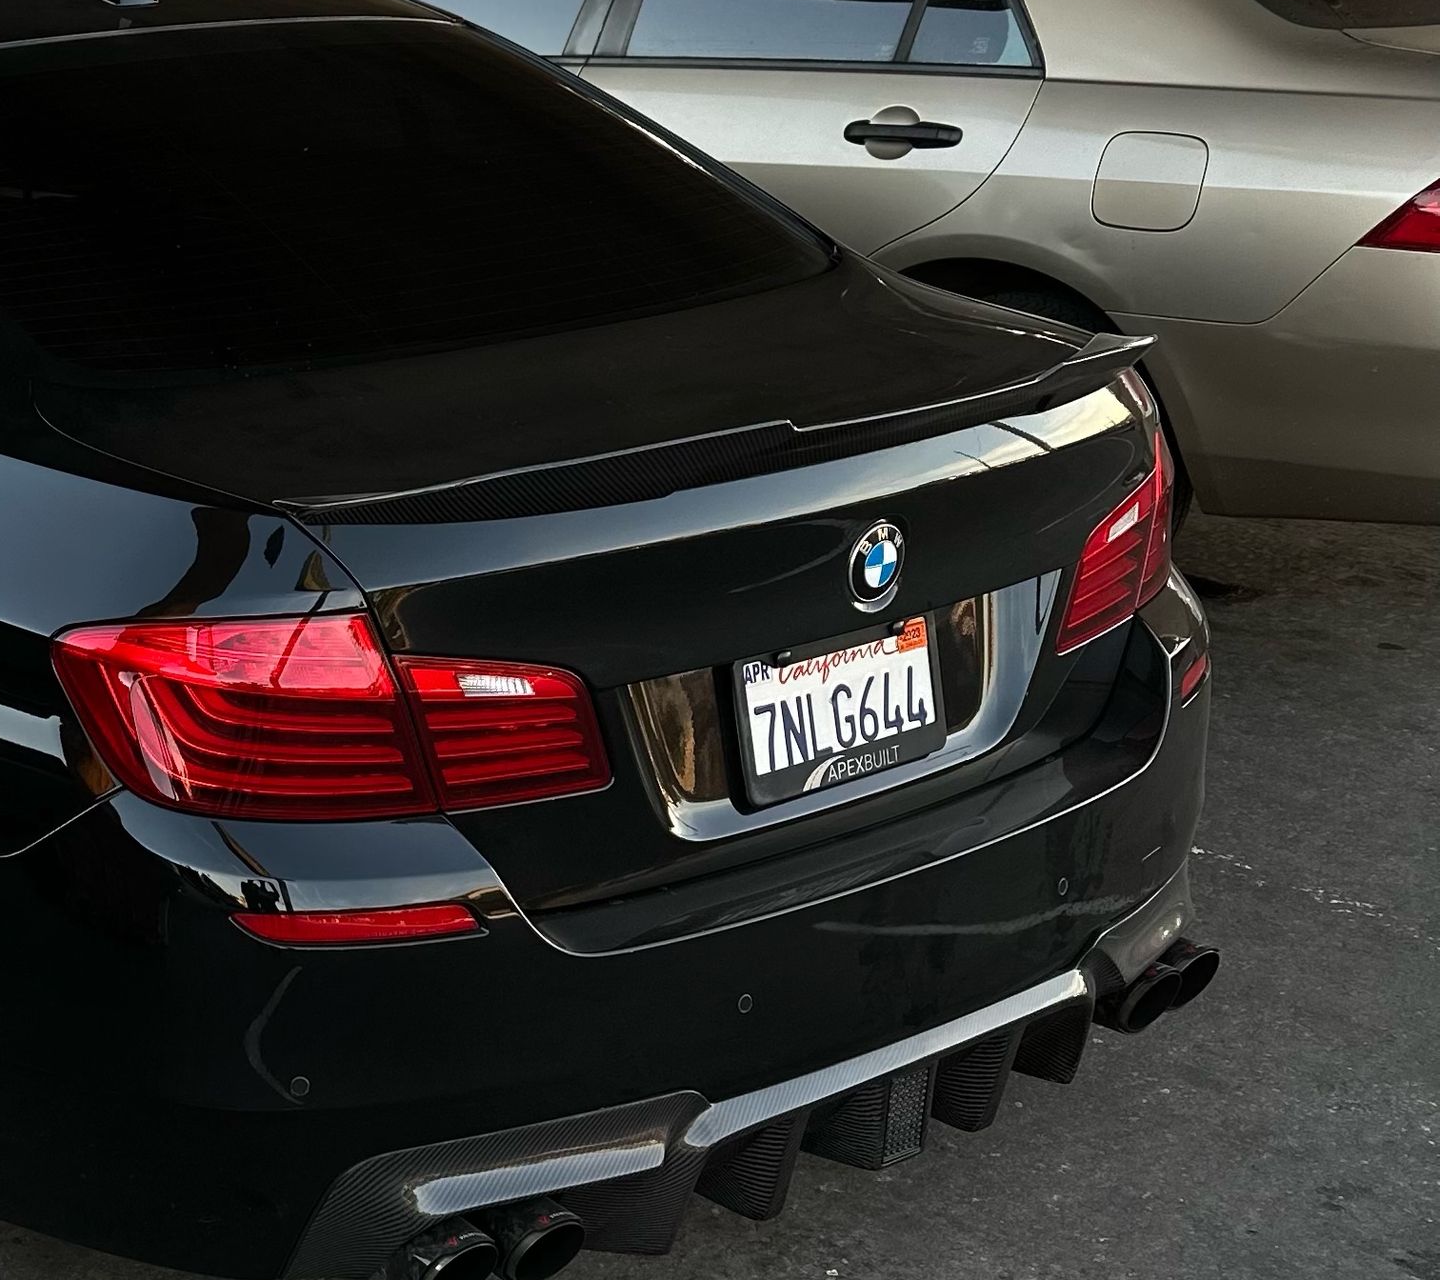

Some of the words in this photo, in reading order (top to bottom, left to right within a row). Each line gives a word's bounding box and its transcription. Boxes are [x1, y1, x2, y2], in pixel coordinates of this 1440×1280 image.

[860, 527, 903, 556] BMW
[744, 662, 770, 685] APR
[778, 639, 896, 685] California
[754, 665, 928, 770] 7NLG644
[827, 745, 900, 783] APEXBUILT
